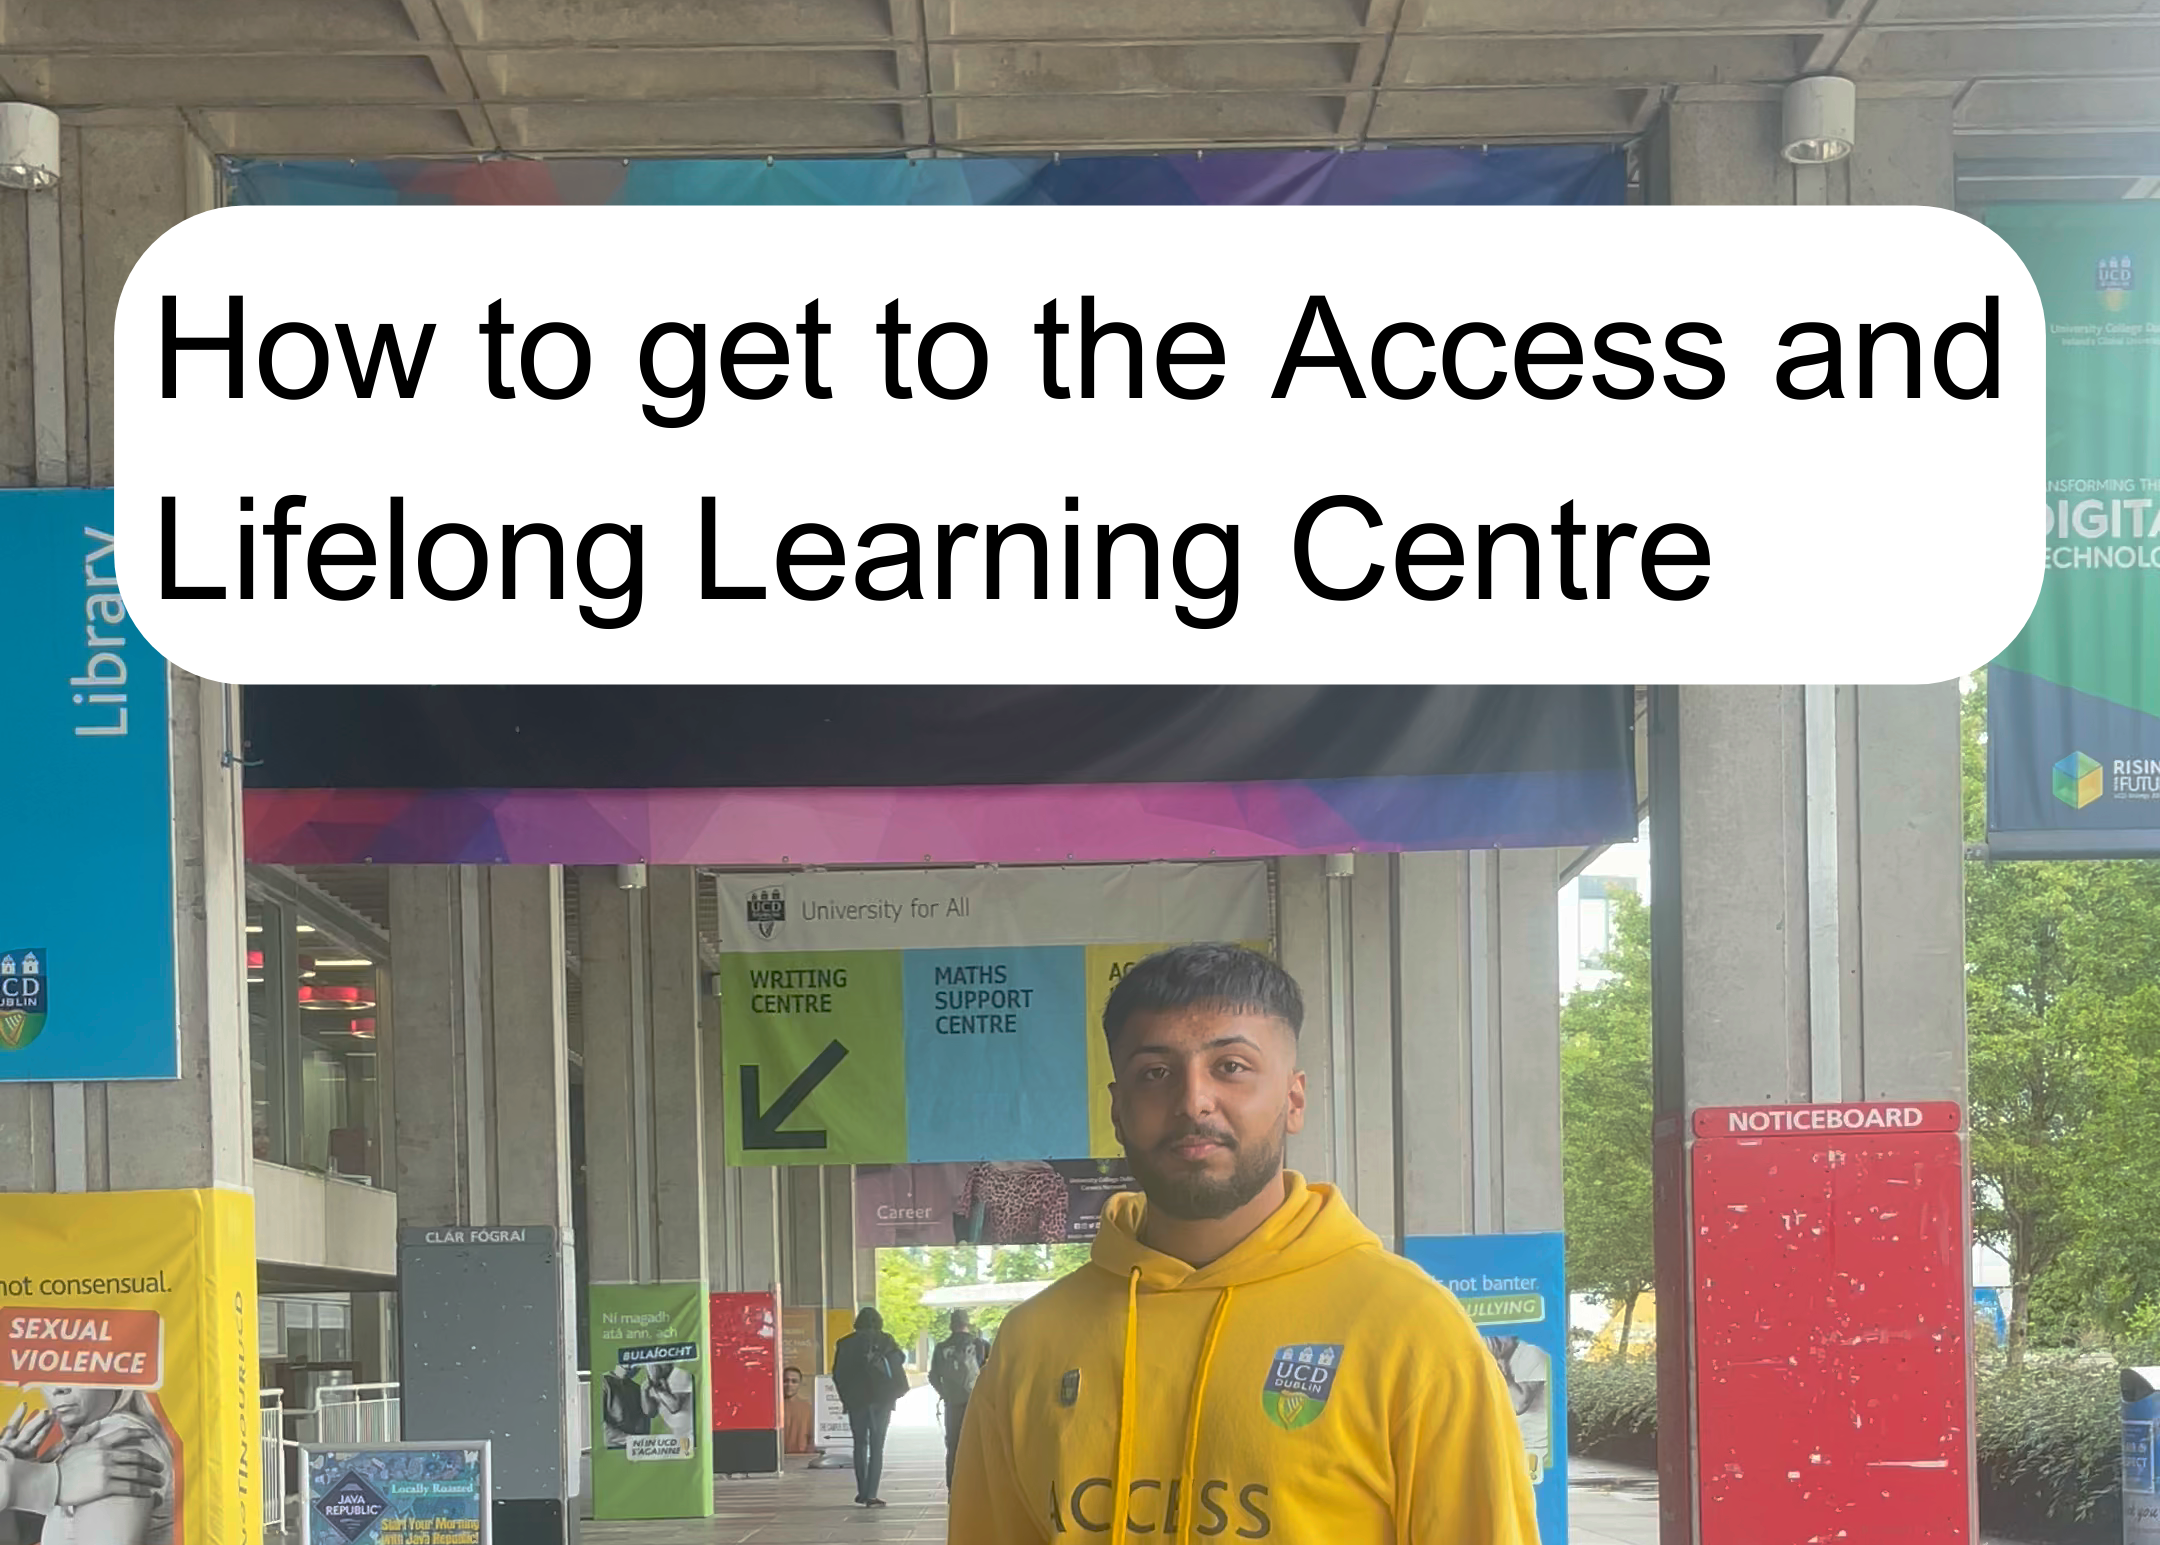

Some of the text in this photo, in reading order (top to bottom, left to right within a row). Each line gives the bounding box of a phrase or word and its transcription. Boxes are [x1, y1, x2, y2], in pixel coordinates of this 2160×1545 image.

[2098, 269, 2131, 281] UCD
[69, 526, 128, 736] Library
[752, 901, 782, 912] UCD
[802, 897, 970, 923] University for All
[750, 968, 847, 989] WRITING
[935, 965, 1007, 986] MATHS
[751, 994, 832, 1013] CENTRE
[935, 989, 1033, 1010] SUPPORT
[936, 1014, 1017, 1034] CENTRE
[1729, 1108, 1922, 1132] NOTICEBOARD
[877, 1205, 932, 1220] Career
[39, 1270, 172, 1296] consensual.
[1450, 1276, 1478, 1291] not
[1483, 1274, 1540, 1291] banter.
[1466, 1300, 1536, 1317] ULLYING
[9, 1317, 112, 1341] SEXUAL
[11, 1348, 147, 1374] VIOLENCE
[1276, 1361, 1328, 1384] UCD
[1274, 1378, 1322, 1393] DUBLIN
[337, 1494, 366, 1505] JAVA
[391, 1483, 430, 1496] Locally
[325, 1505, 378, 1516] REPUBLIC
